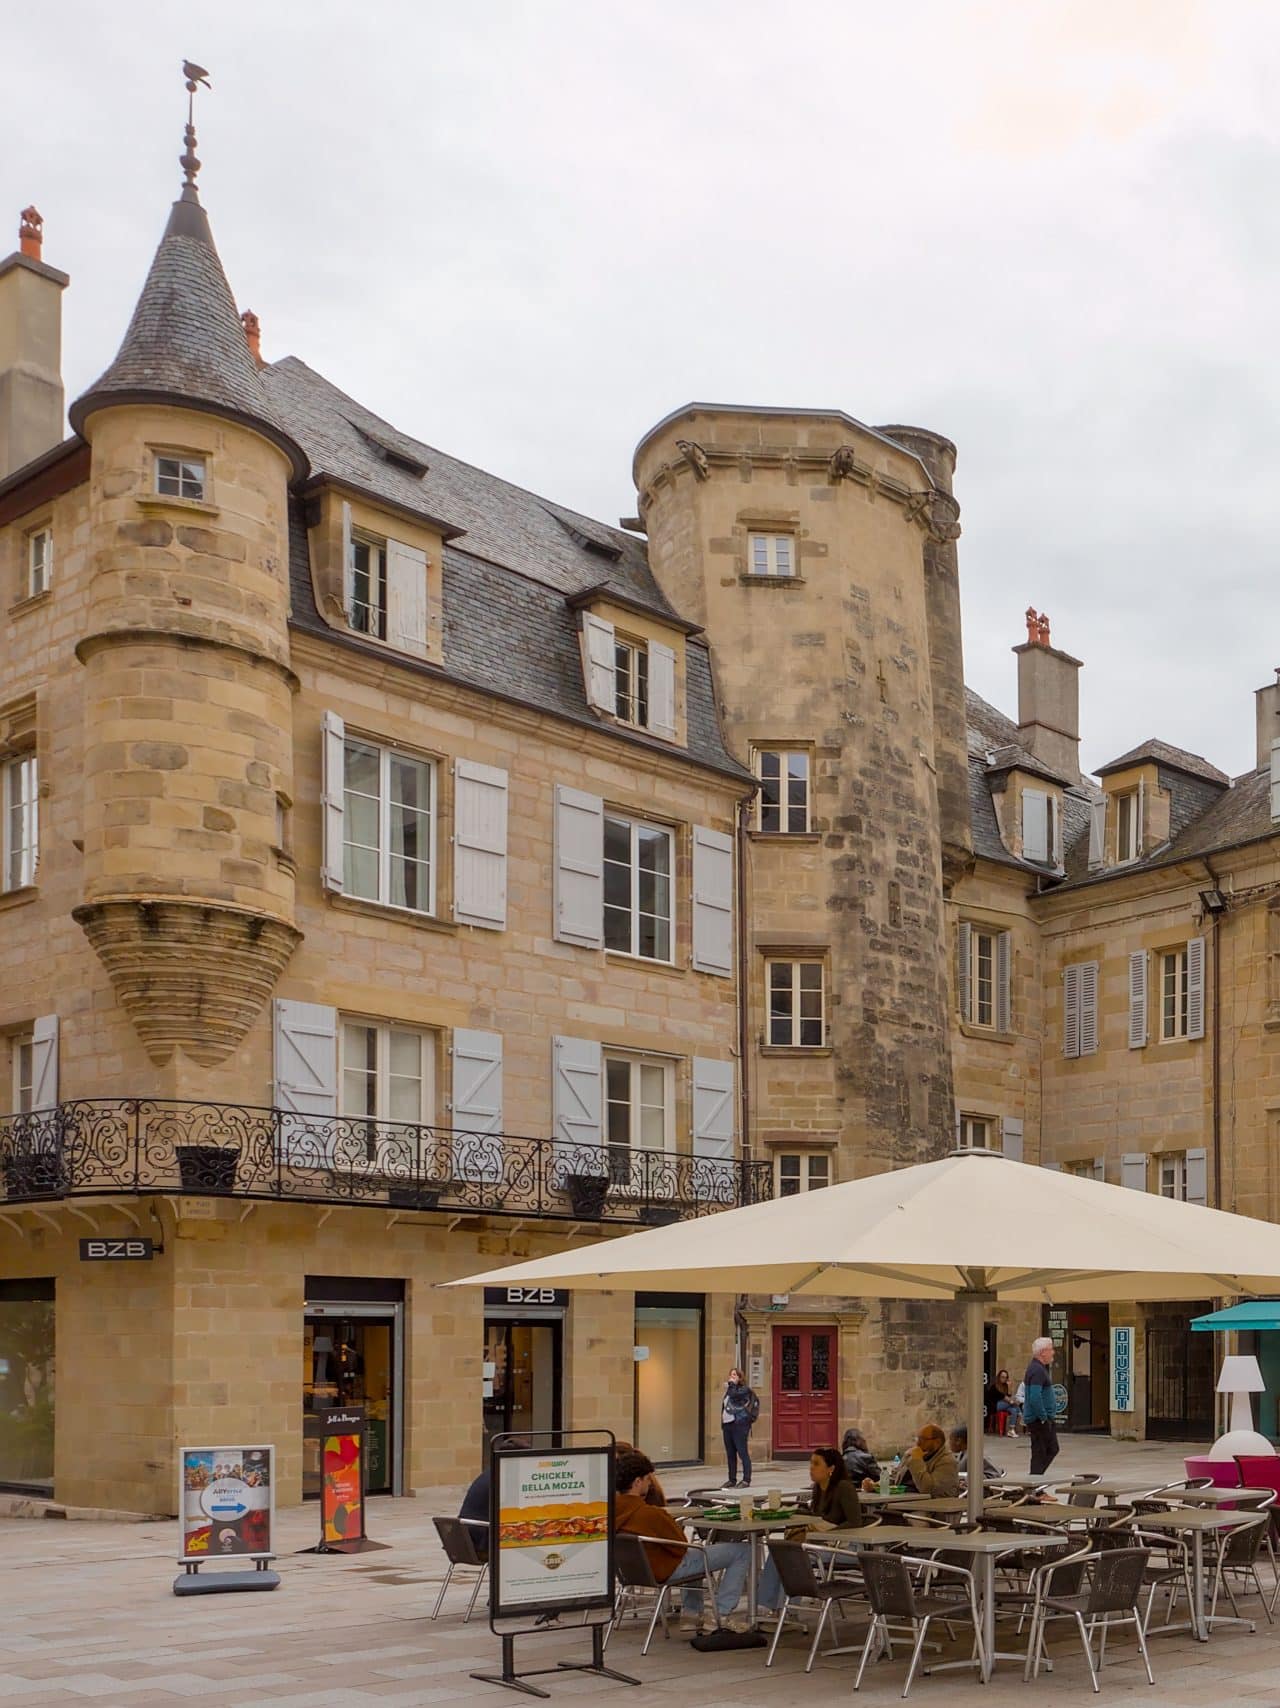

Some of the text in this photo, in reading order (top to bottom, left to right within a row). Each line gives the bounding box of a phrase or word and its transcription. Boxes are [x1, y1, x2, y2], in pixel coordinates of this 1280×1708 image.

[87, 1242, 146, 1257] BZB
[506, 1287, 556, 1303] BZB
[1115, 1328, 1130, 1410] OUVERT
[531, 1471, 574, 1481] CHICKEN
[522, 1481, 586, 1492] BELLA MOZZA
